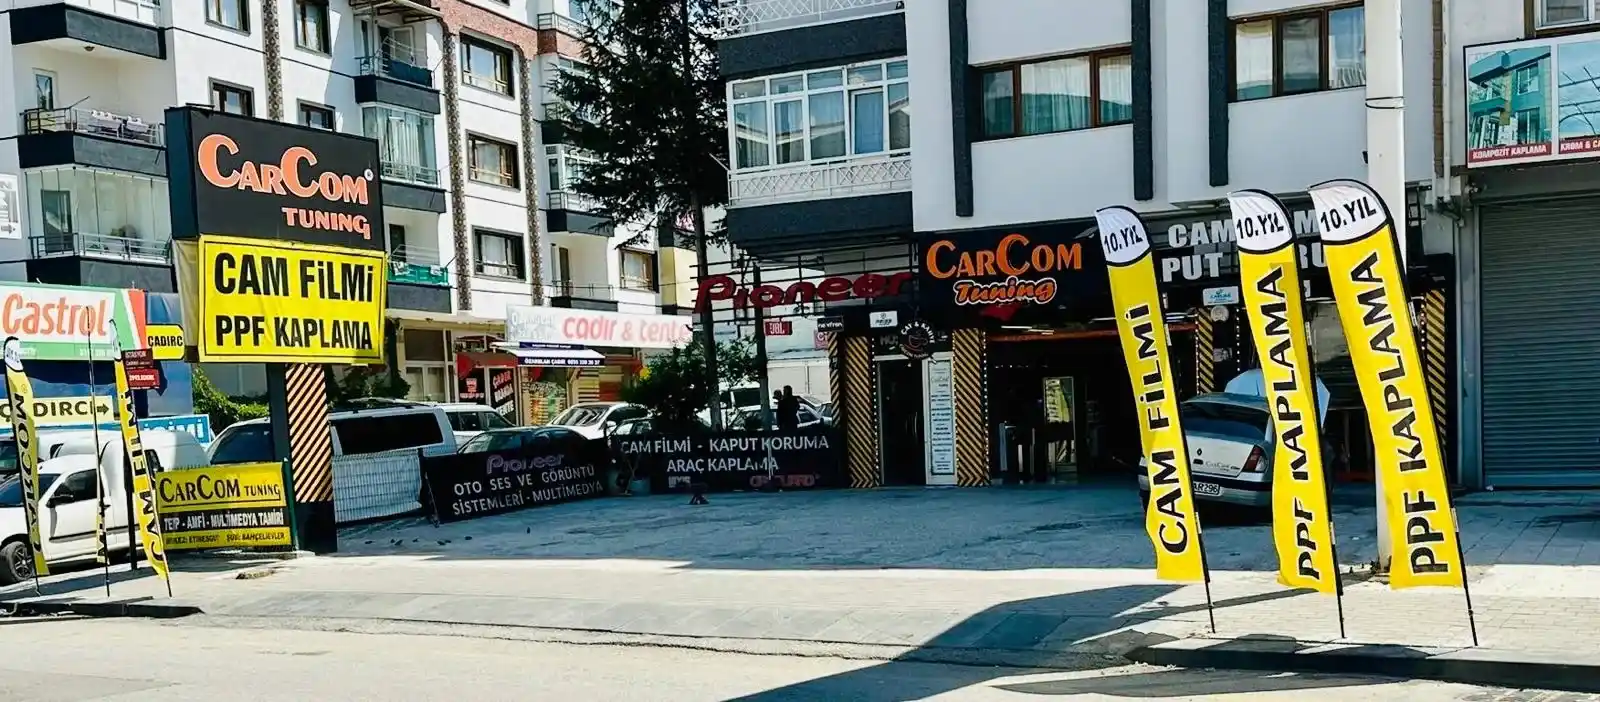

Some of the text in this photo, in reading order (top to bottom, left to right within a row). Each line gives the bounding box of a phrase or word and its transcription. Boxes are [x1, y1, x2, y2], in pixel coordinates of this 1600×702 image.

[1511, 145, 1547, 156] KAPLAMA
[1560, 141, 1583, 151] KROM
[282, 207, 371, 240] TUNING
[1320, 196, 1376, 232] 10.YIL
[1104, 225, 1143, 254] 10.YIL
[1168, 219, 1236, 248] CAM
[214, 253, 289, 297] CAM
[1162, 252, 1223, 282] PUT
[694, 271, 913, 313] Pioneer
[953, 276, 1056, 305] Tuning
[2, 293, 108, 336] Castrol
[216, 315, 372, 350] PPF KAPLAMA
[621, 321, 632, 342] &
[0, 400, 93, 422] ÇDIRCI
[1350, 251, 1448, 575] PPF KAPLAMA
[621, 441, 650, 454] CAM
[655, 436, 691, 452] FİLMİ
[709, 437, 758, 451] KAPUT
[761, 435, 829, 450] KORUMA
[454, 463, 595, 496] OTO SES VE GÖRÜNTÜ
[667, 457, 779, 474] ARAÇ KAPLAMA
[244, 484, 281, 499] TUNING
[452, 490, 524, 516] SİSTEMLERİ
[532, 480, 603, 502] MULTİMEDYA
[1149, 450, 1188, 554] CAM
[1294, 498, 1320, 580] PPF
